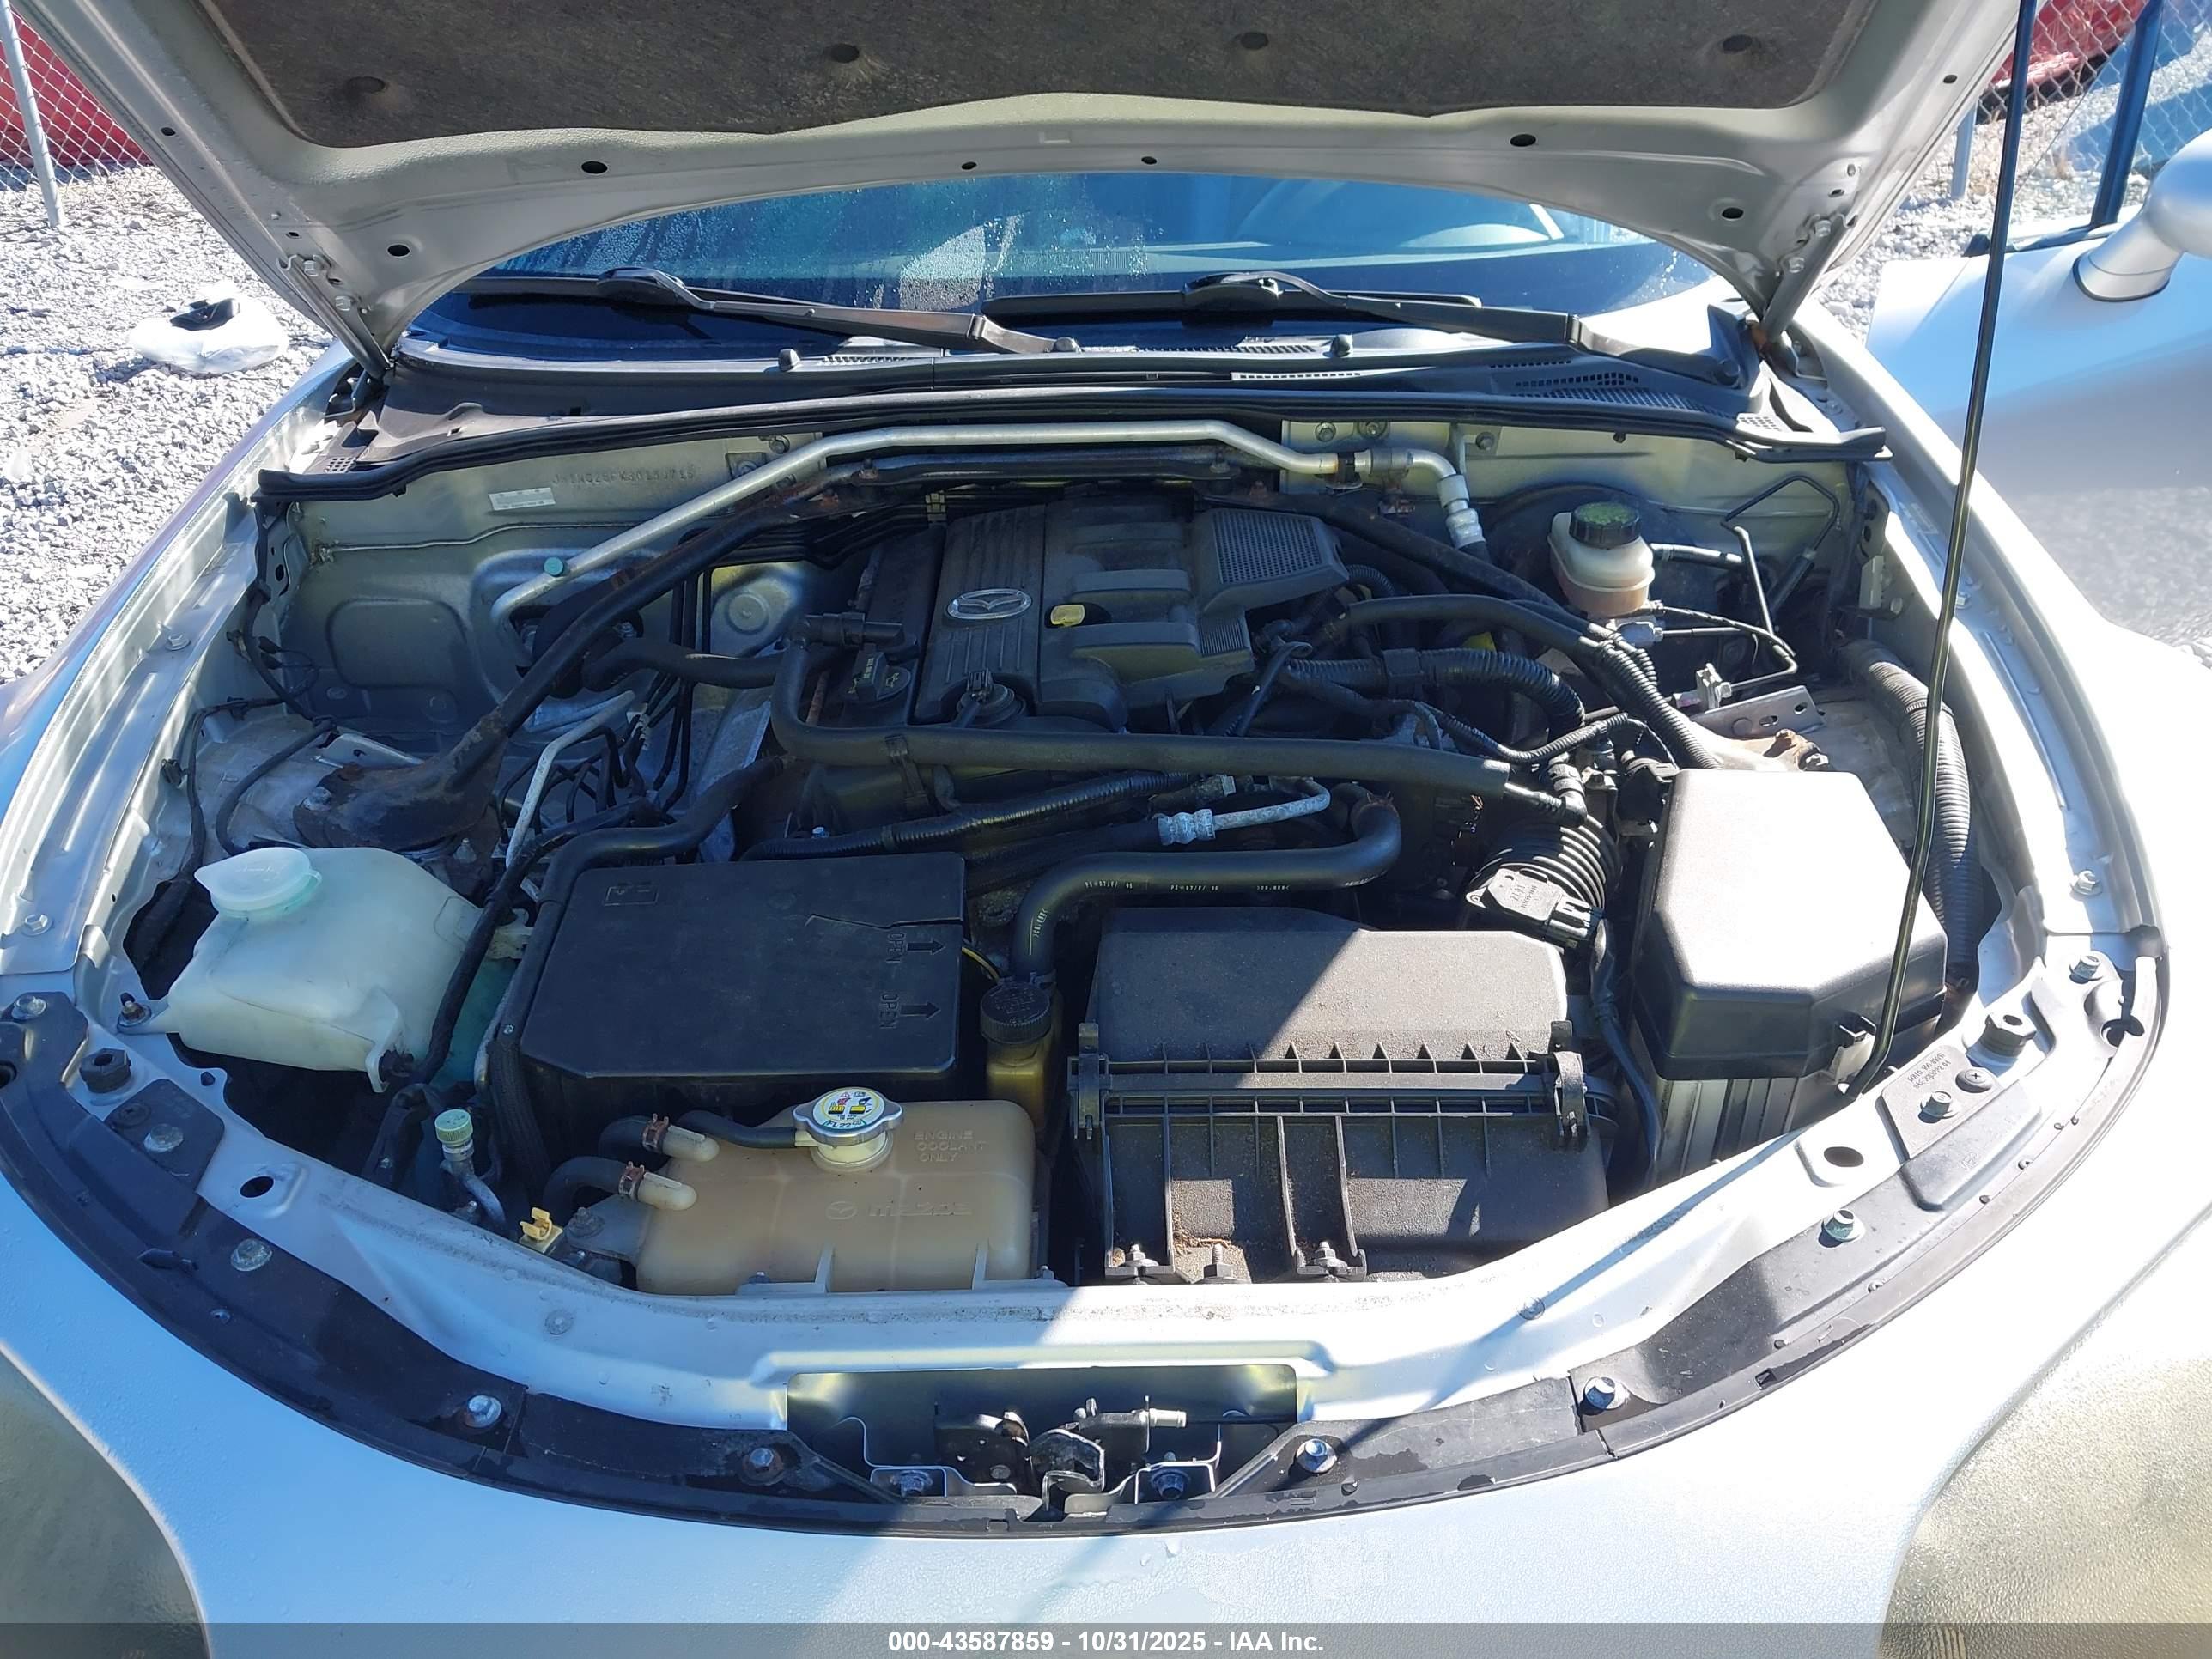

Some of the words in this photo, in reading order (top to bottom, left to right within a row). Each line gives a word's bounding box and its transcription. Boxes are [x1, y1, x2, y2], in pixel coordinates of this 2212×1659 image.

[885, 933, 907, 964] OPEN
[878, 993, 900, 1030] OPEN
[914, 1130, 974, 1140] ENGINE
[917, 1140, 988, 1152] COOLANT
[919, 1152, 958, 1162] ONLY
